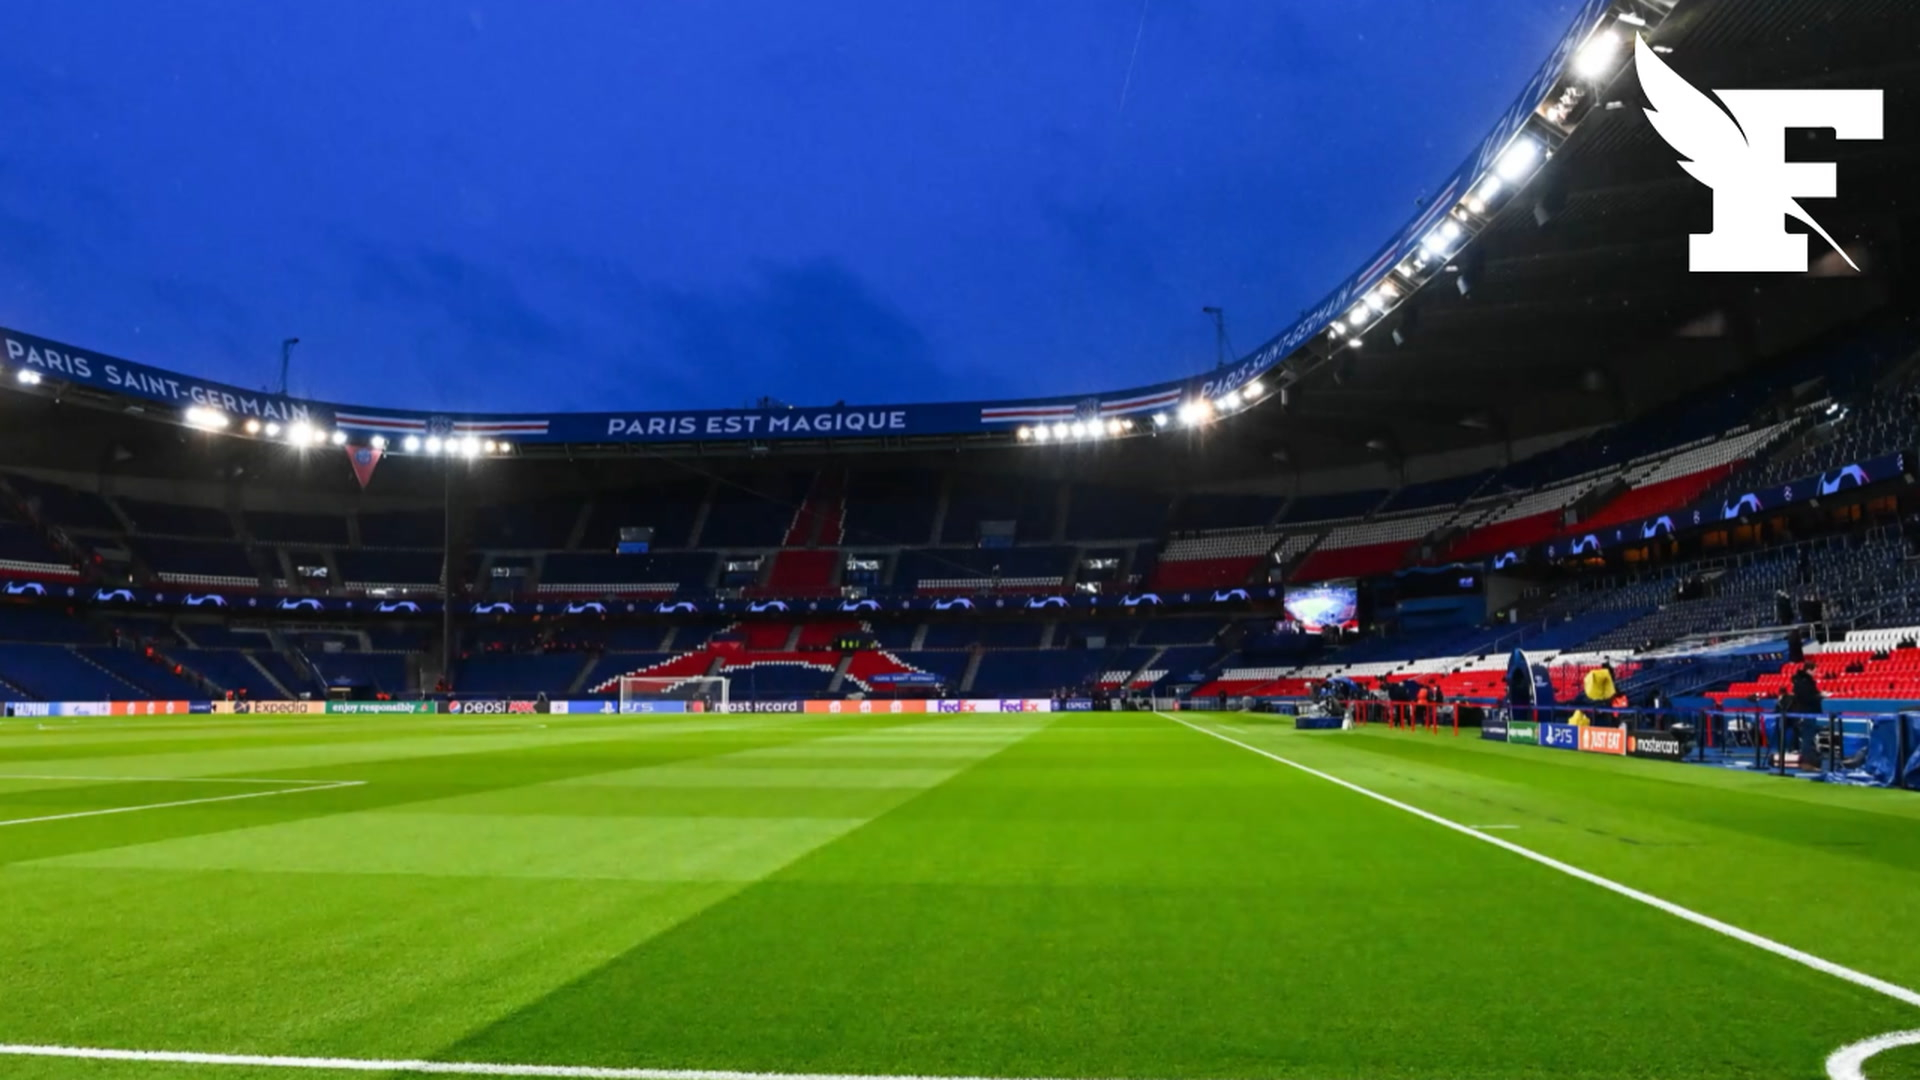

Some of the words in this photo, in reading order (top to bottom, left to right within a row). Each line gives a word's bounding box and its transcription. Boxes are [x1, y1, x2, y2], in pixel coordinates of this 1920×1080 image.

[5, 338, 92, 378] PARIS
[104, 364, 311, 422] SAINT-GERMAIN
[1200, 361, 1249, 400] PARIS
[607, 416, 697, 435] PARIS
[705, 415, 762, 434] EST
[768, 411, 906, 432] MAGIQUE
[254, 701, 308, 714] Expedia
[332, 702, 357, 714] enjoy
[360, 702, 415, 714] responsibly
[463, 701, 507, 714] pepsi
[937, 701, 977, 713] FedEx
[1000, 701, 1038, 713] FedEx
[1554, 728, 1573, 744] PS5
[1591, 730, 1607, 749] JUST
[1607, 731, 1621, 750] EAT
[1637, 736, 1680, 755] mastercard
